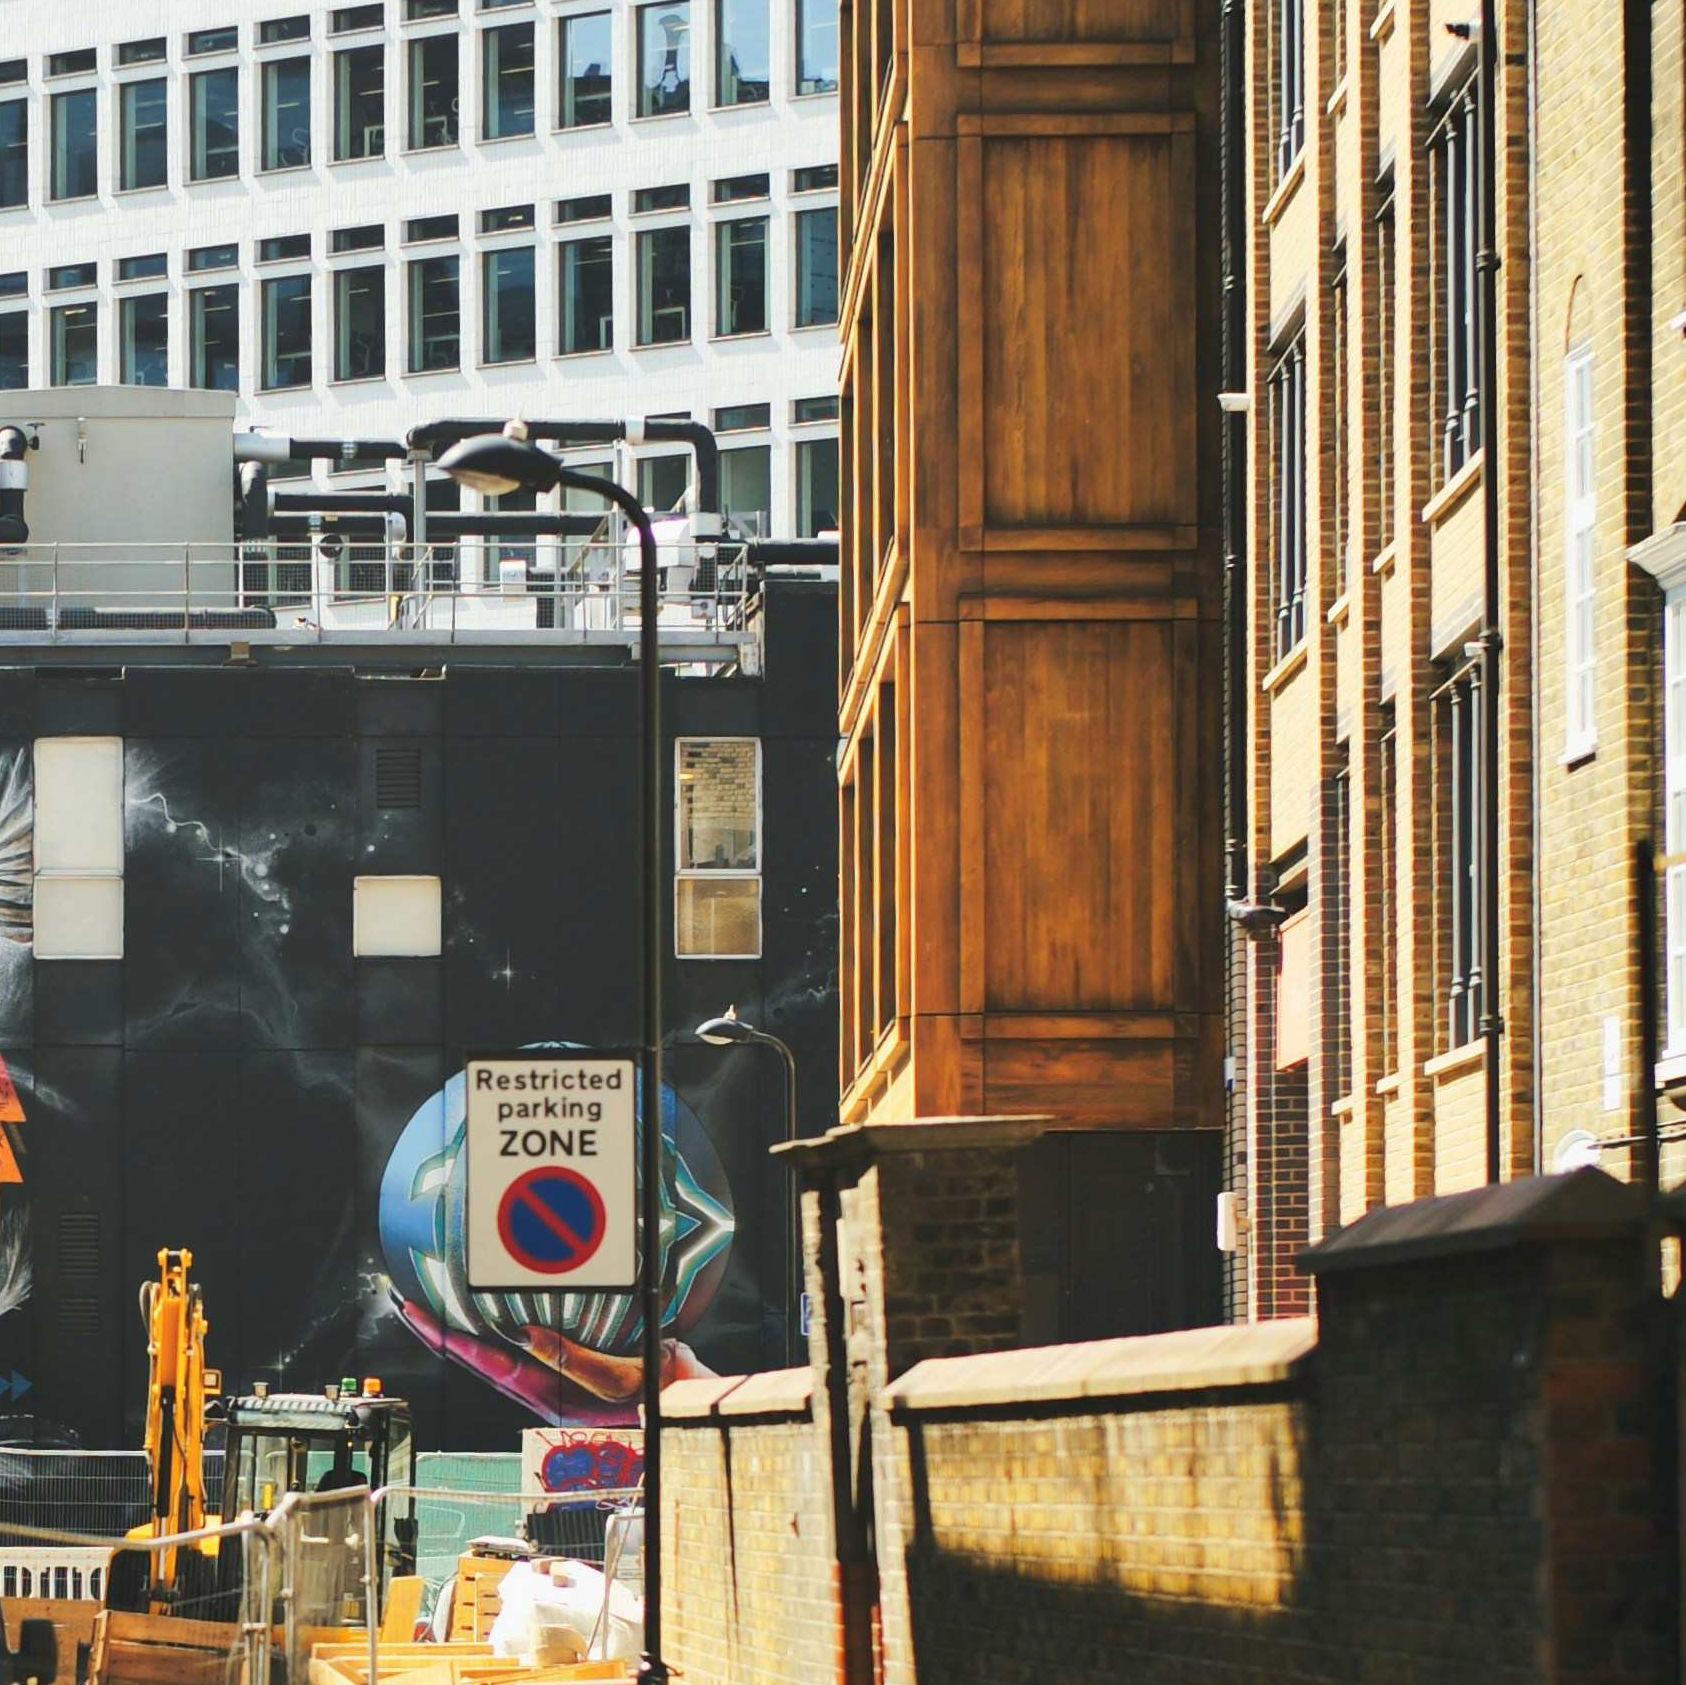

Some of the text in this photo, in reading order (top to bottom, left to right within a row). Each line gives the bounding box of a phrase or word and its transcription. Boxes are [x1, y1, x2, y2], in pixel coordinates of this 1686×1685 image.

[476, 1068, 622, 1091] Restricted
[498, 1097, 602, 1122] parking
[499, 1129, 598, 1157] ZONE
